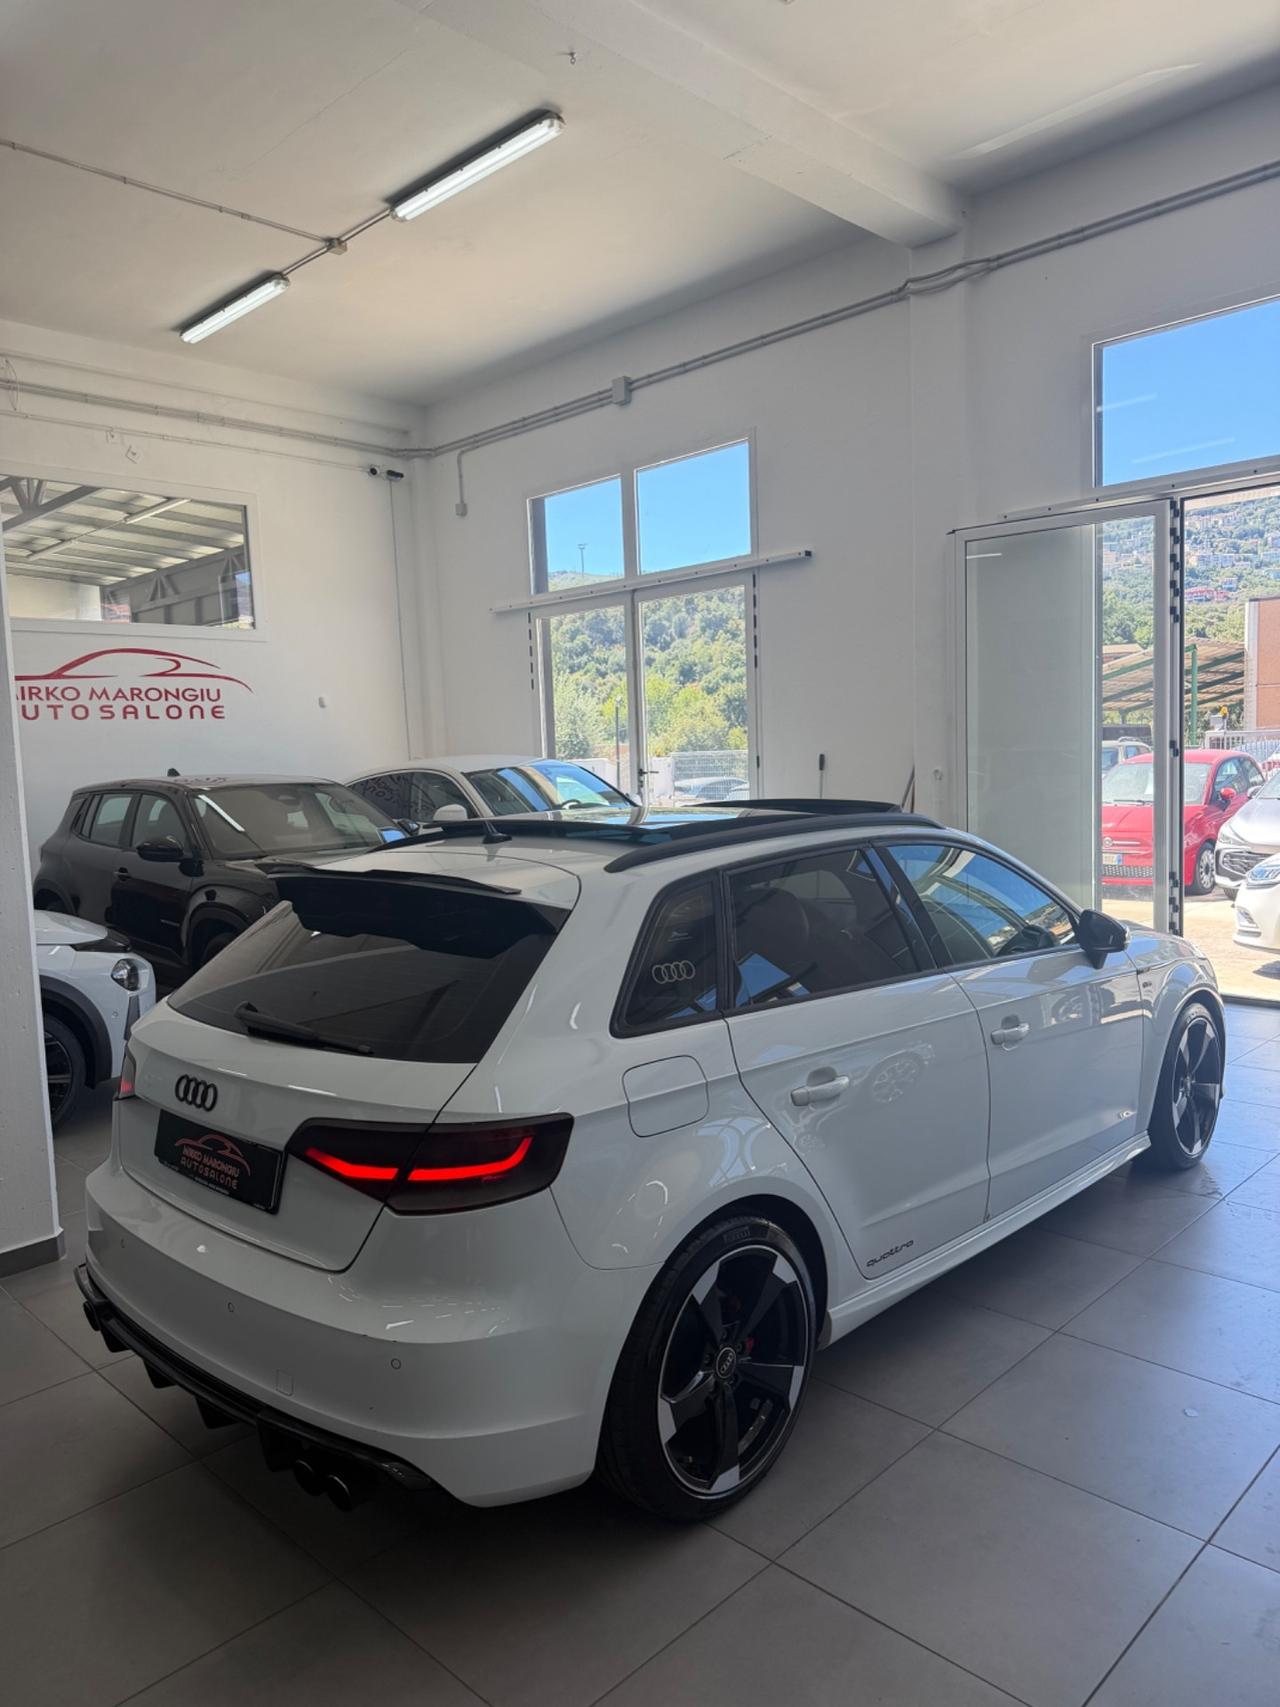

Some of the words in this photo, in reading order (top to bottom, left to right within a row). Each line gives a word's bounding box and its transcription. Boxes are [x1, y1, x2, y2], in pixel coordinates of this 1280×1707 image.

[16, 685, 81, 702] IRKO
[88, 686, 222, 703] MARONGIU
[21, 704, 226, 721] UTOSALONE
[180, 1157, 239, 1189] AUTOSALONE
[866, 1239, 914, 1268] quattro
